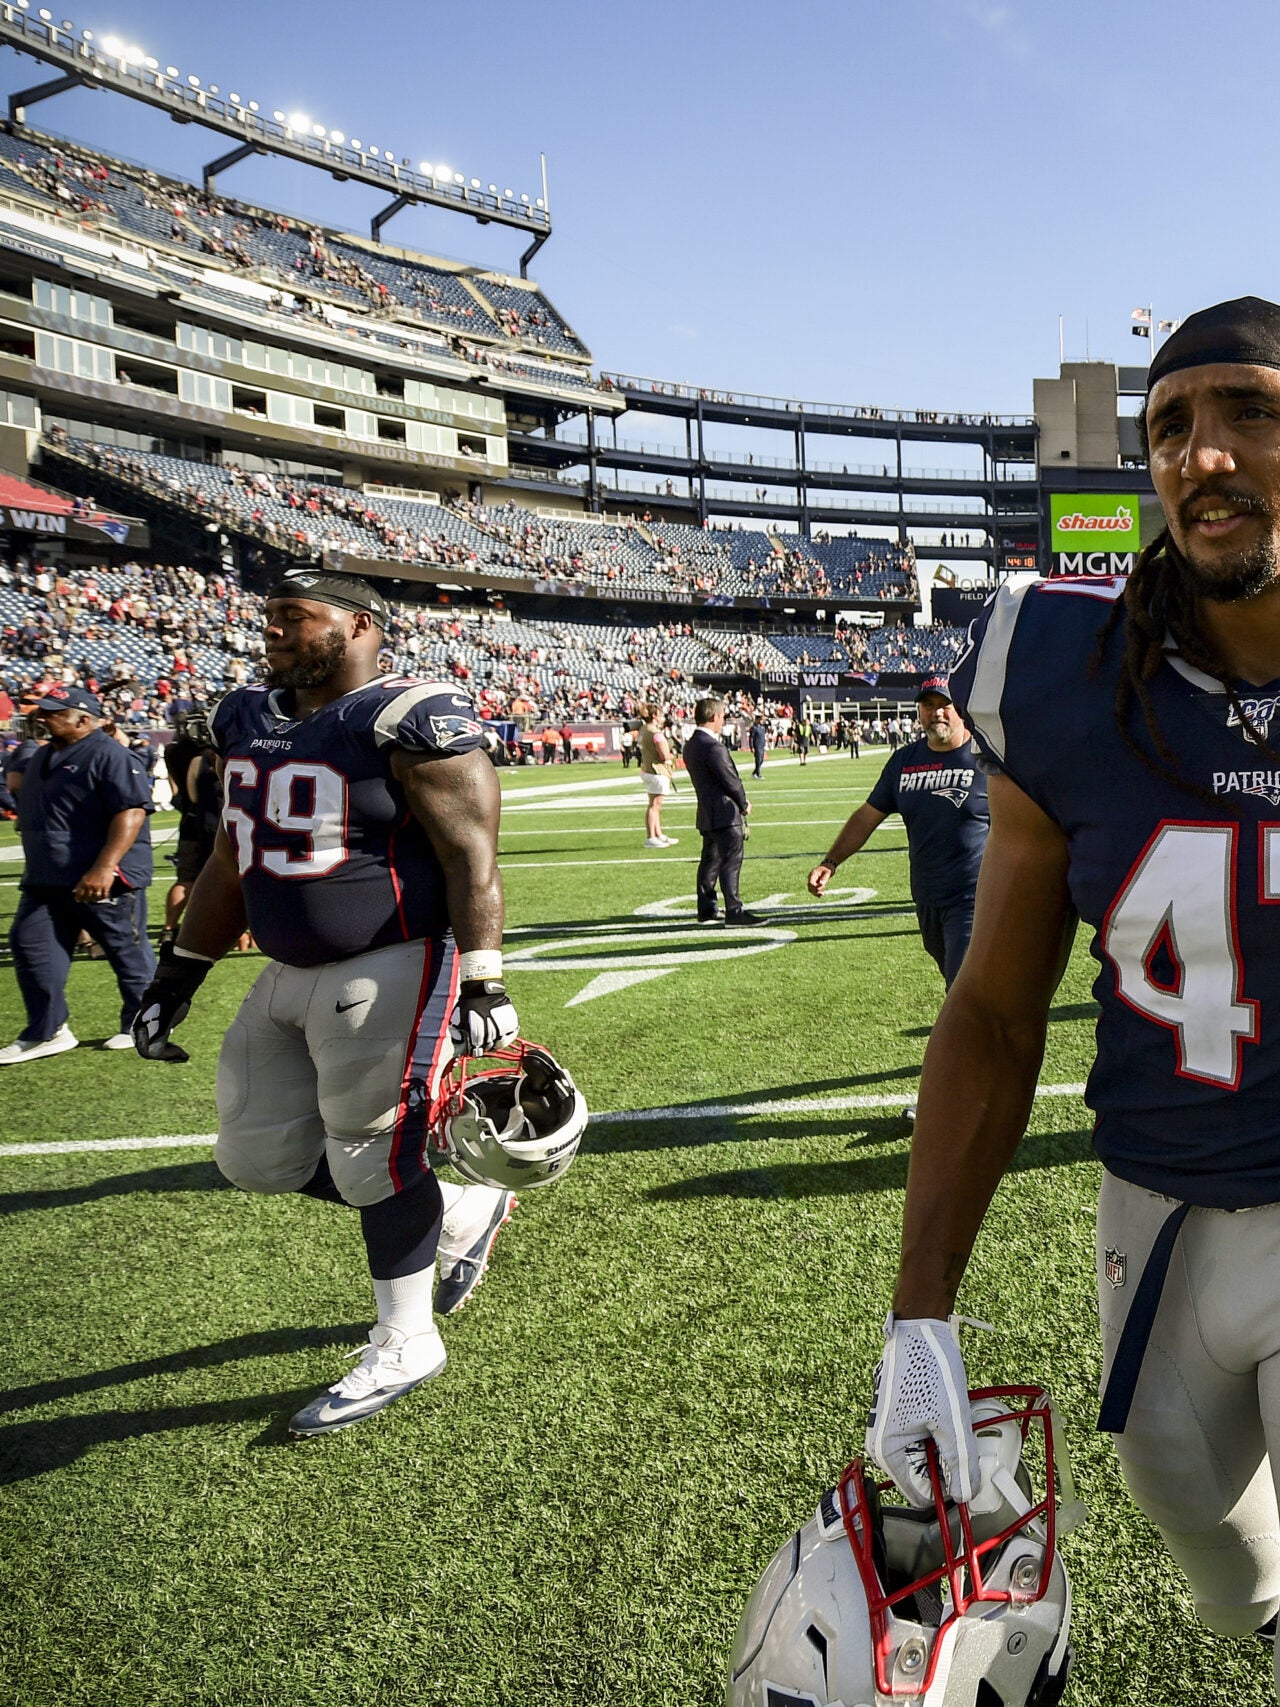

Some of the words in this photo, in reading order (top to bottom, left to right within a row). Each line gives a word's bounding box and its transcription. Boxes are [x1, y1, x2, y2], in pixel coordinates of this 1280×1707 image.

[334, 390, 417, 418] PATRIOTS
[421, 408, 454, 425] WIN
[336, 438, 419, 463] PATRIOTS
[423, 452, 456, 469] WIN
[9, 509, 66, 534] WIN
[1059, 552, 1134, 575] MGM
[596, 587, 663, 601] PATRIOTS
[665, 593, 693, 604] WIN
[961, 578, 999, 592] OPT
[803, 673, 839, 686] WIN
[250, 738, 293, 751] PATRIOTS
[899, 768, 975, 793] PATRIOTS
[222, 757, 350, 880] 69
